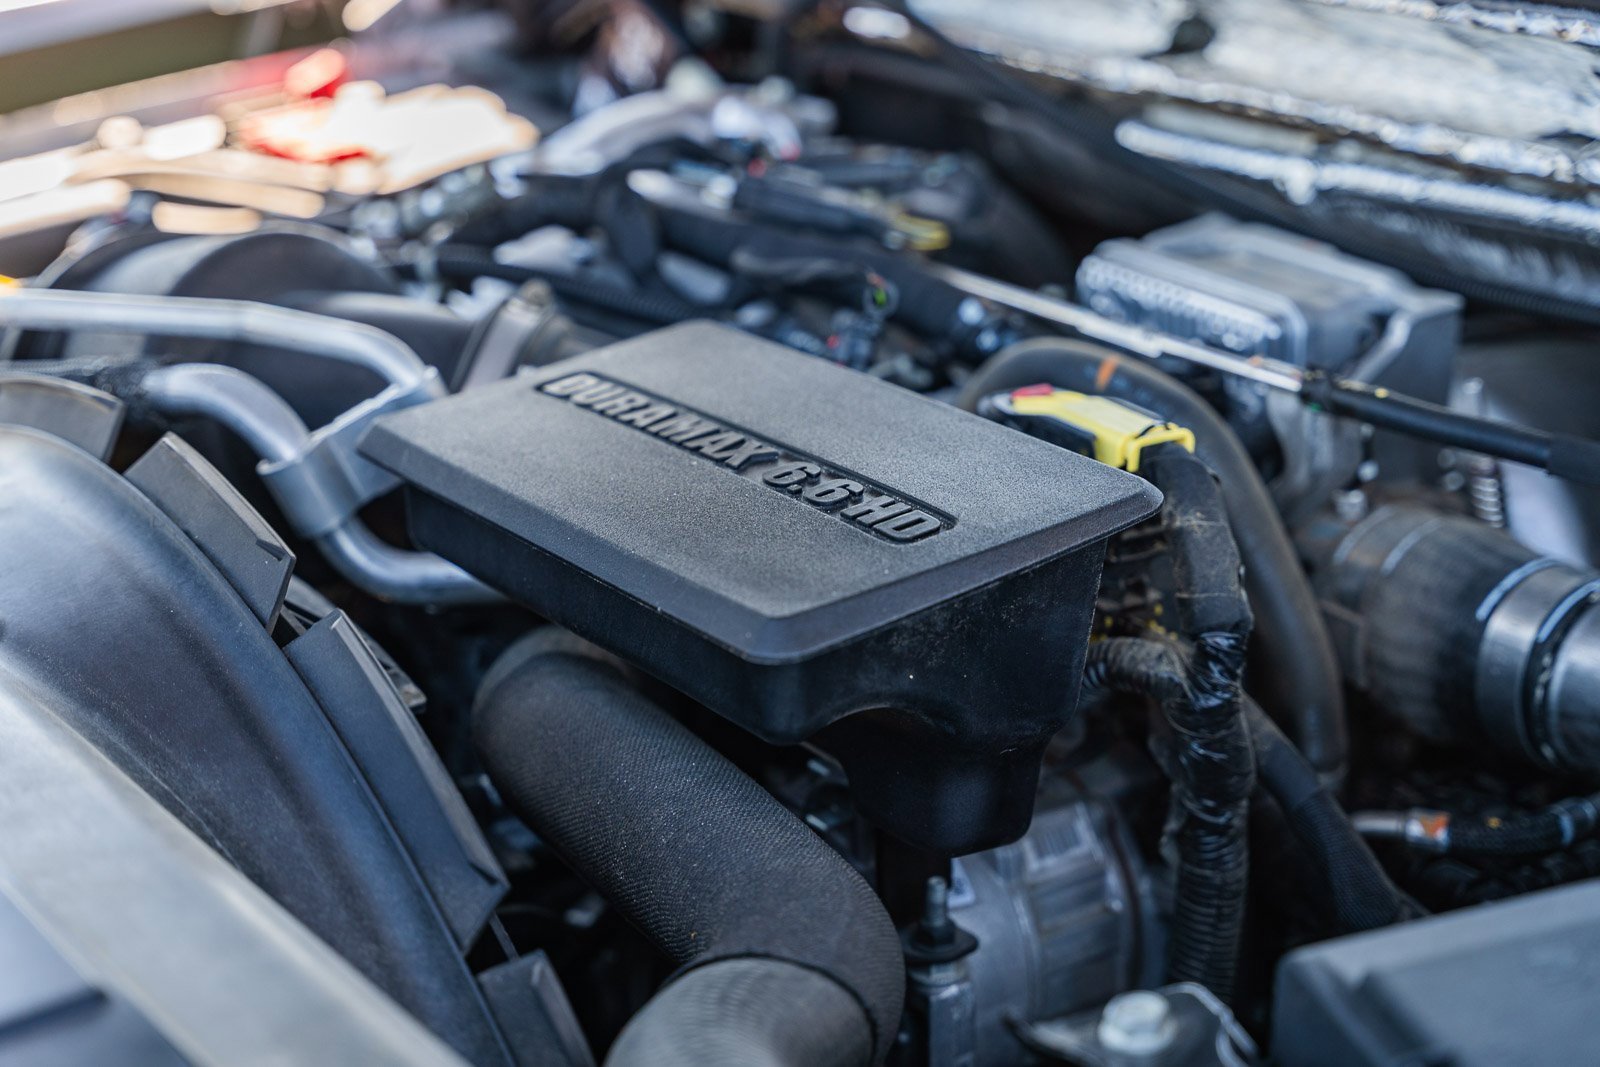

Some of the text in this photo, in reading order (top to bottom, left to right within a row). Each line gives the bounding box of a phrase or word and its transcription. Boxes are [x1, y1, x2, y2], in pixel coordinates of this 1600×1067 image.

[544, 373, 942, 541] DURAMAX 6.6 HD
